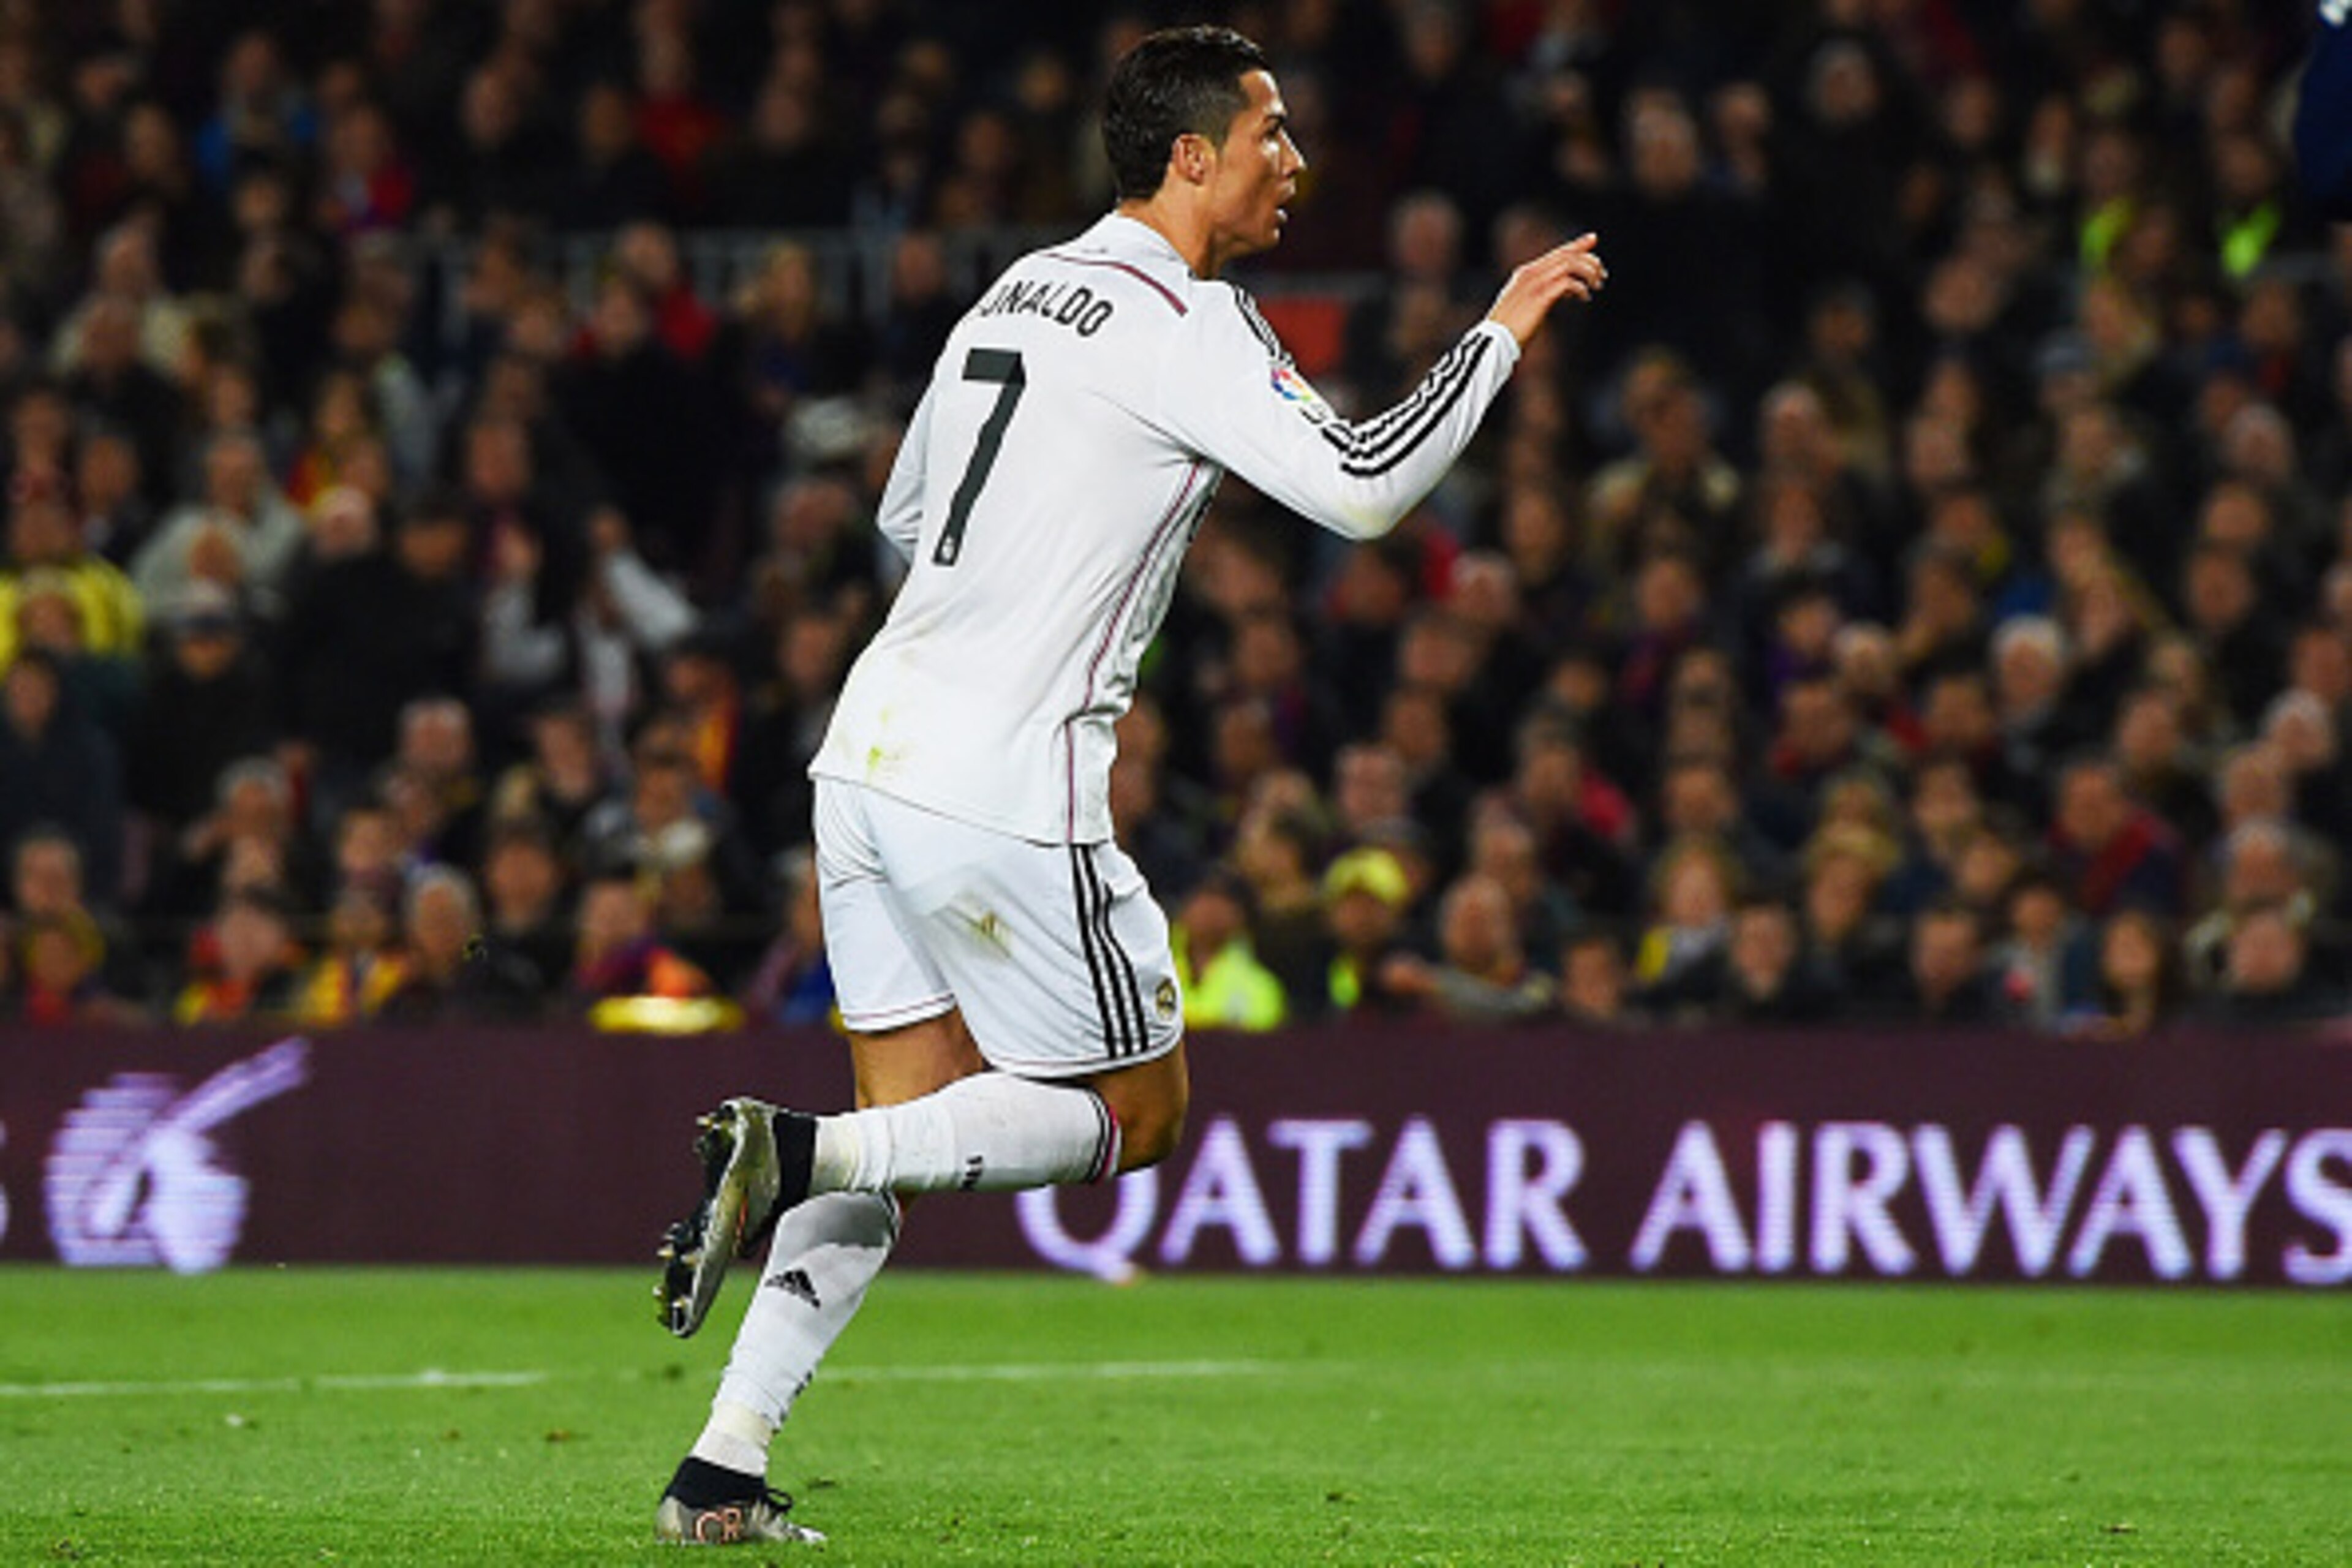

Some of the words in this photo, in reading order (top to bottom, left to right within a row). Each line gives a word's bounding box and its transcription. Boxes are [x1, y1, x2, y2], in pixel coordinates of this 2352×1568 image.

[979, 281, 1113, 336] ONALDO
[933, 347, 1026, 566] 7
[1015, 1115, 1589, 1284] QATAR
[1629, 1120, 2352, 1284] AIRWAYS
